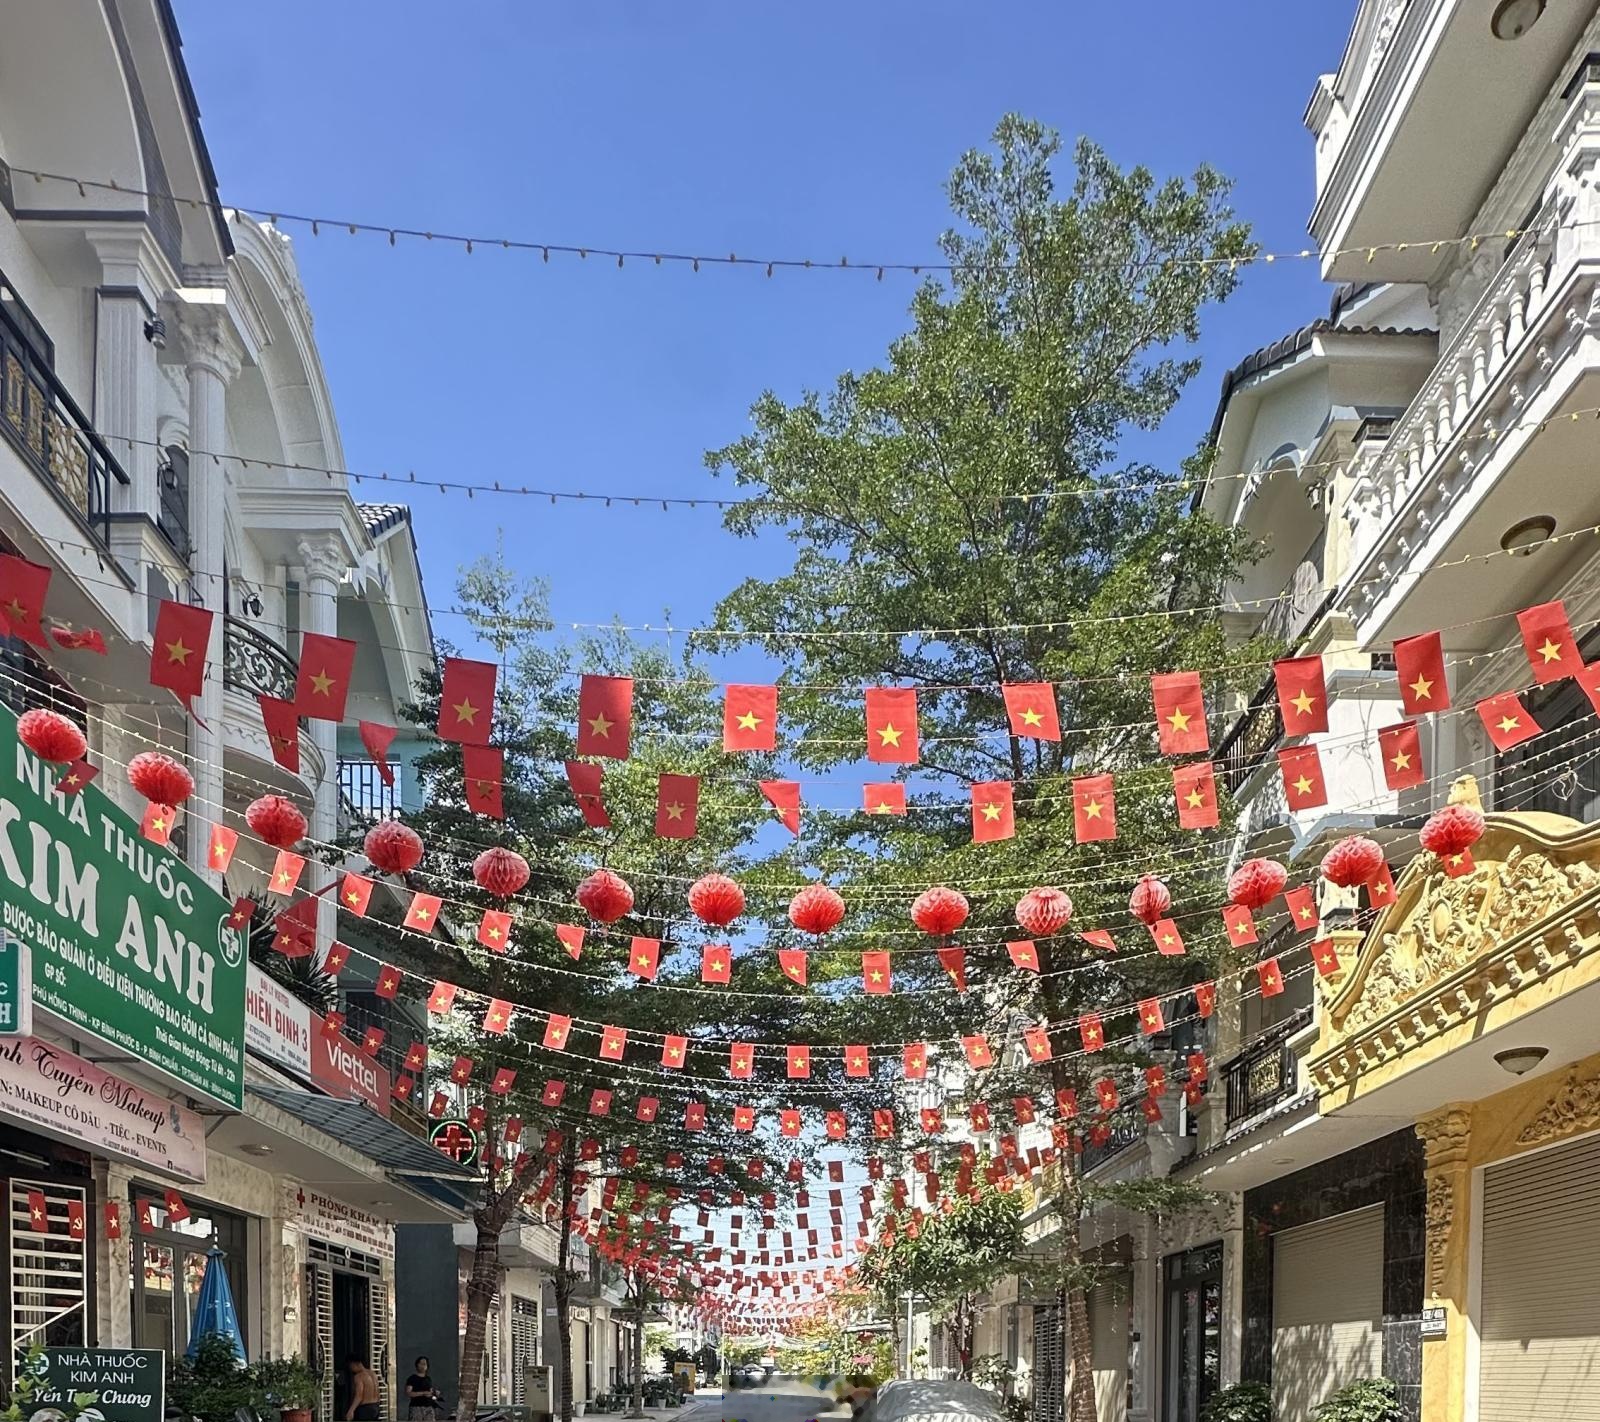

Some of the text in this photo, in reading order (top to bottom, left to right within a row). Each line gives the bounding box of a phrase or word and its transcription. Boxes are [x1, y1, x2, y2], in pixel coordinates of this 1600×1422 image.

[16, 742, 193, 915] NHÀ THUỐC
[4, 901, 35, 940] ĐƯỢC
[36, 919, 58, 952] BẢO
[59, 938, 86, 971] QUẢN
[165, 1003, 180, 1028] BAO
[44, 962, 54, 980] GP
[115, 894, 215, 1014] ANH
[301, 1028, 308, 1053] 3
[326, 1039, 380, 1098] viettel
[15, 1084, 62, 1113] MAKEUP
[64, 1104, 79, 1120] CÔ
[136, 1133, 167, 1155] EVENTS
[100, 1076, 166, 1134] Makeup
[310, 1193, 348, 1216] PHÒNG
[58, 1352, 148, 1369] NHÀ THUỐC
[70, 1371, 134, 1384] KIM ANH
